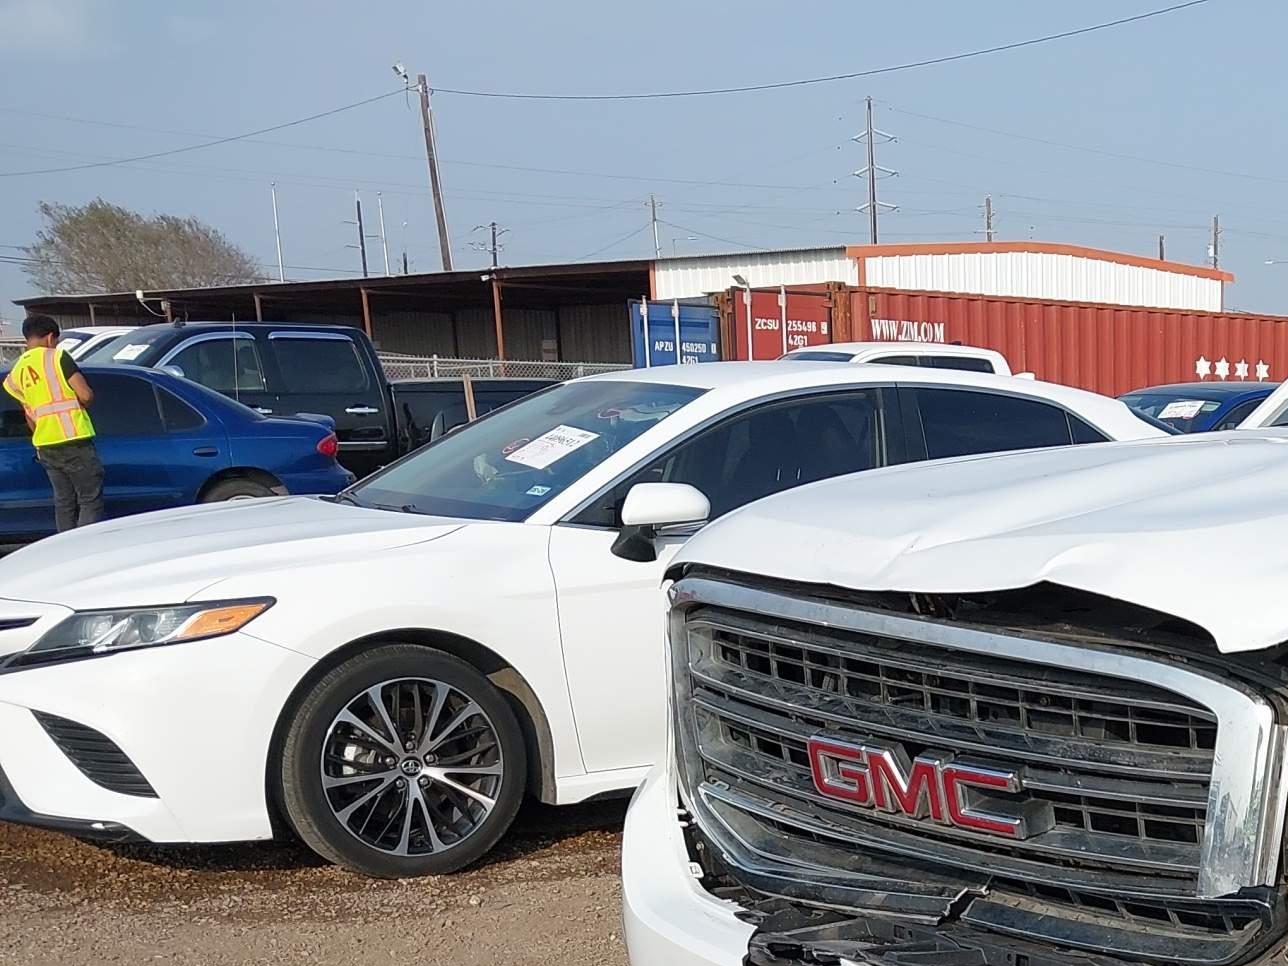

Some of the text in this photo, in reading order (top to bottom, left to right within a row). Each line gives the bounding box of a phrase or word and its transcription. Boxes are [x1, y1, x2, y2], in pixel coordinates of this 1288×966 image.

[754, 318, 780, 330] ZCSU
[787, 320, 817, 333] 255496
[788, 334, 808, 346] 42G1
[654, 341, 674, 352] APZU
[681, 342, 707, 354] 450250
[807, 735, 1027, 840] GMC
